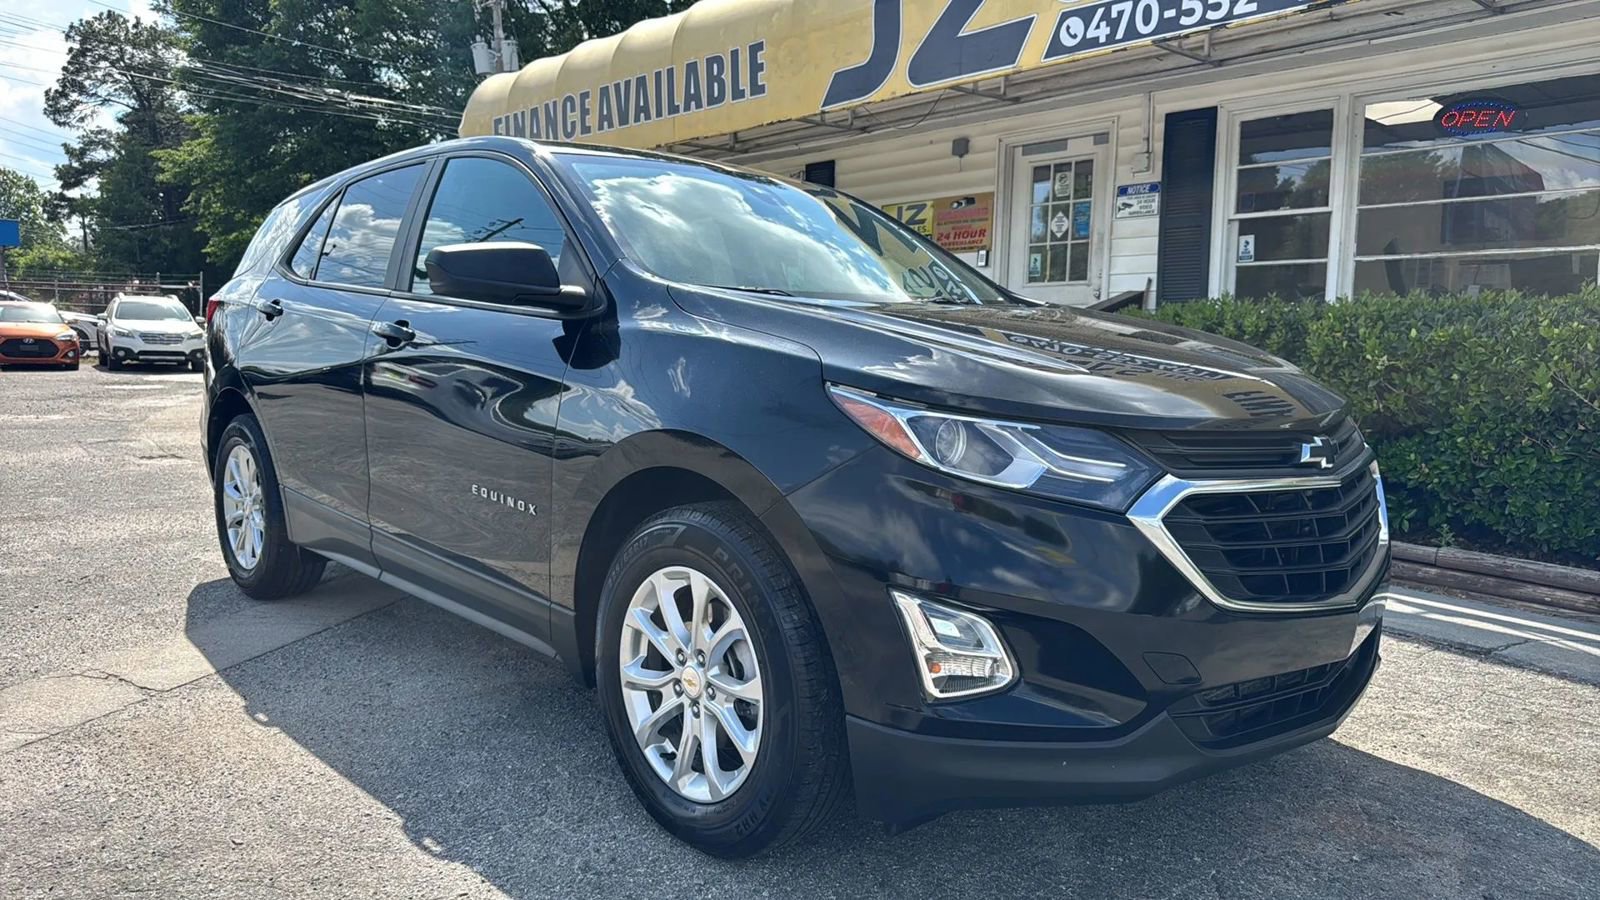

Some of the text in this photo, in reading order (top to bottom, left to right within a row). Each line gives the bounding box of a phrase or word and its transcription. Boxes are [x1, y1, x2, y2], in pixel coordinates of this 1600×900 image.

[493, 39, 767, 140] FINANCE AVAILABLE
[1441, 110, 1516, 128] OPEN
[1126, 184, 1151, 195] NOTICE
[937, 228, 987, 241] 24 HOUR
[471, 484, 537, 516] EQUINOX
